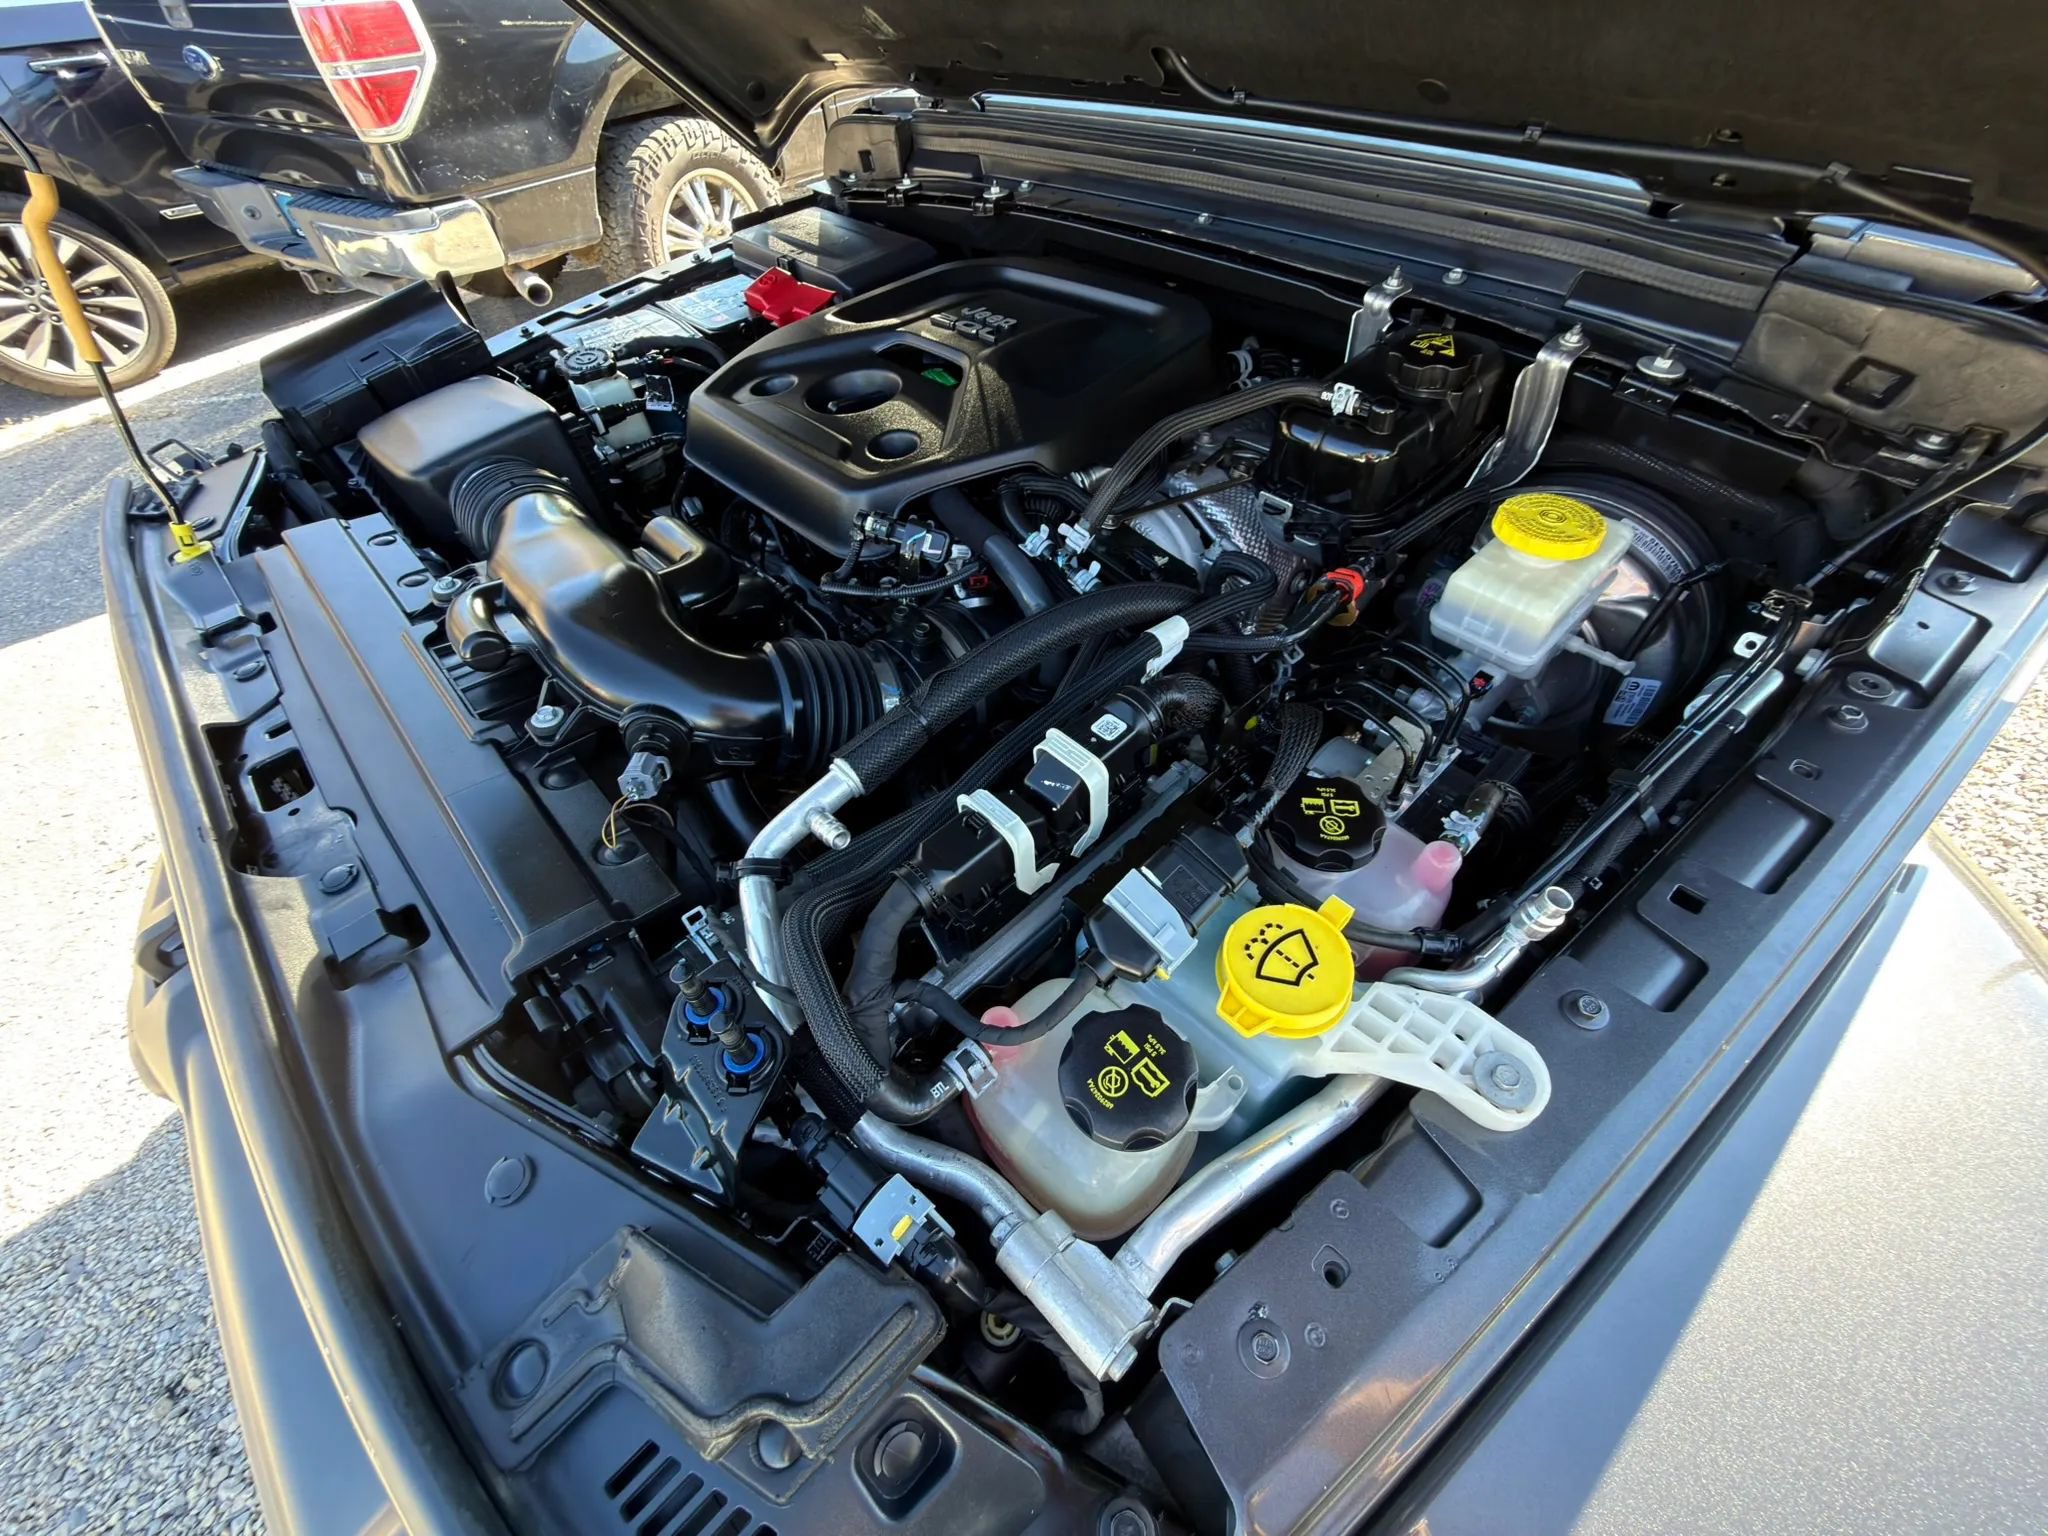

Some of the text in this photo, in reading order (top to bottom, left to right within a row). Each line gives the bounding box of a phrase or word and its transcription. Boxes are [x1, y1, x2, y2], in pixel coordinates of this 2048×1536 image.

[960, 306, 1018, 329] Jeep
[1143, 1042, 1155, 1053] PSI
[929, 1080, 950, 1099] BTL
